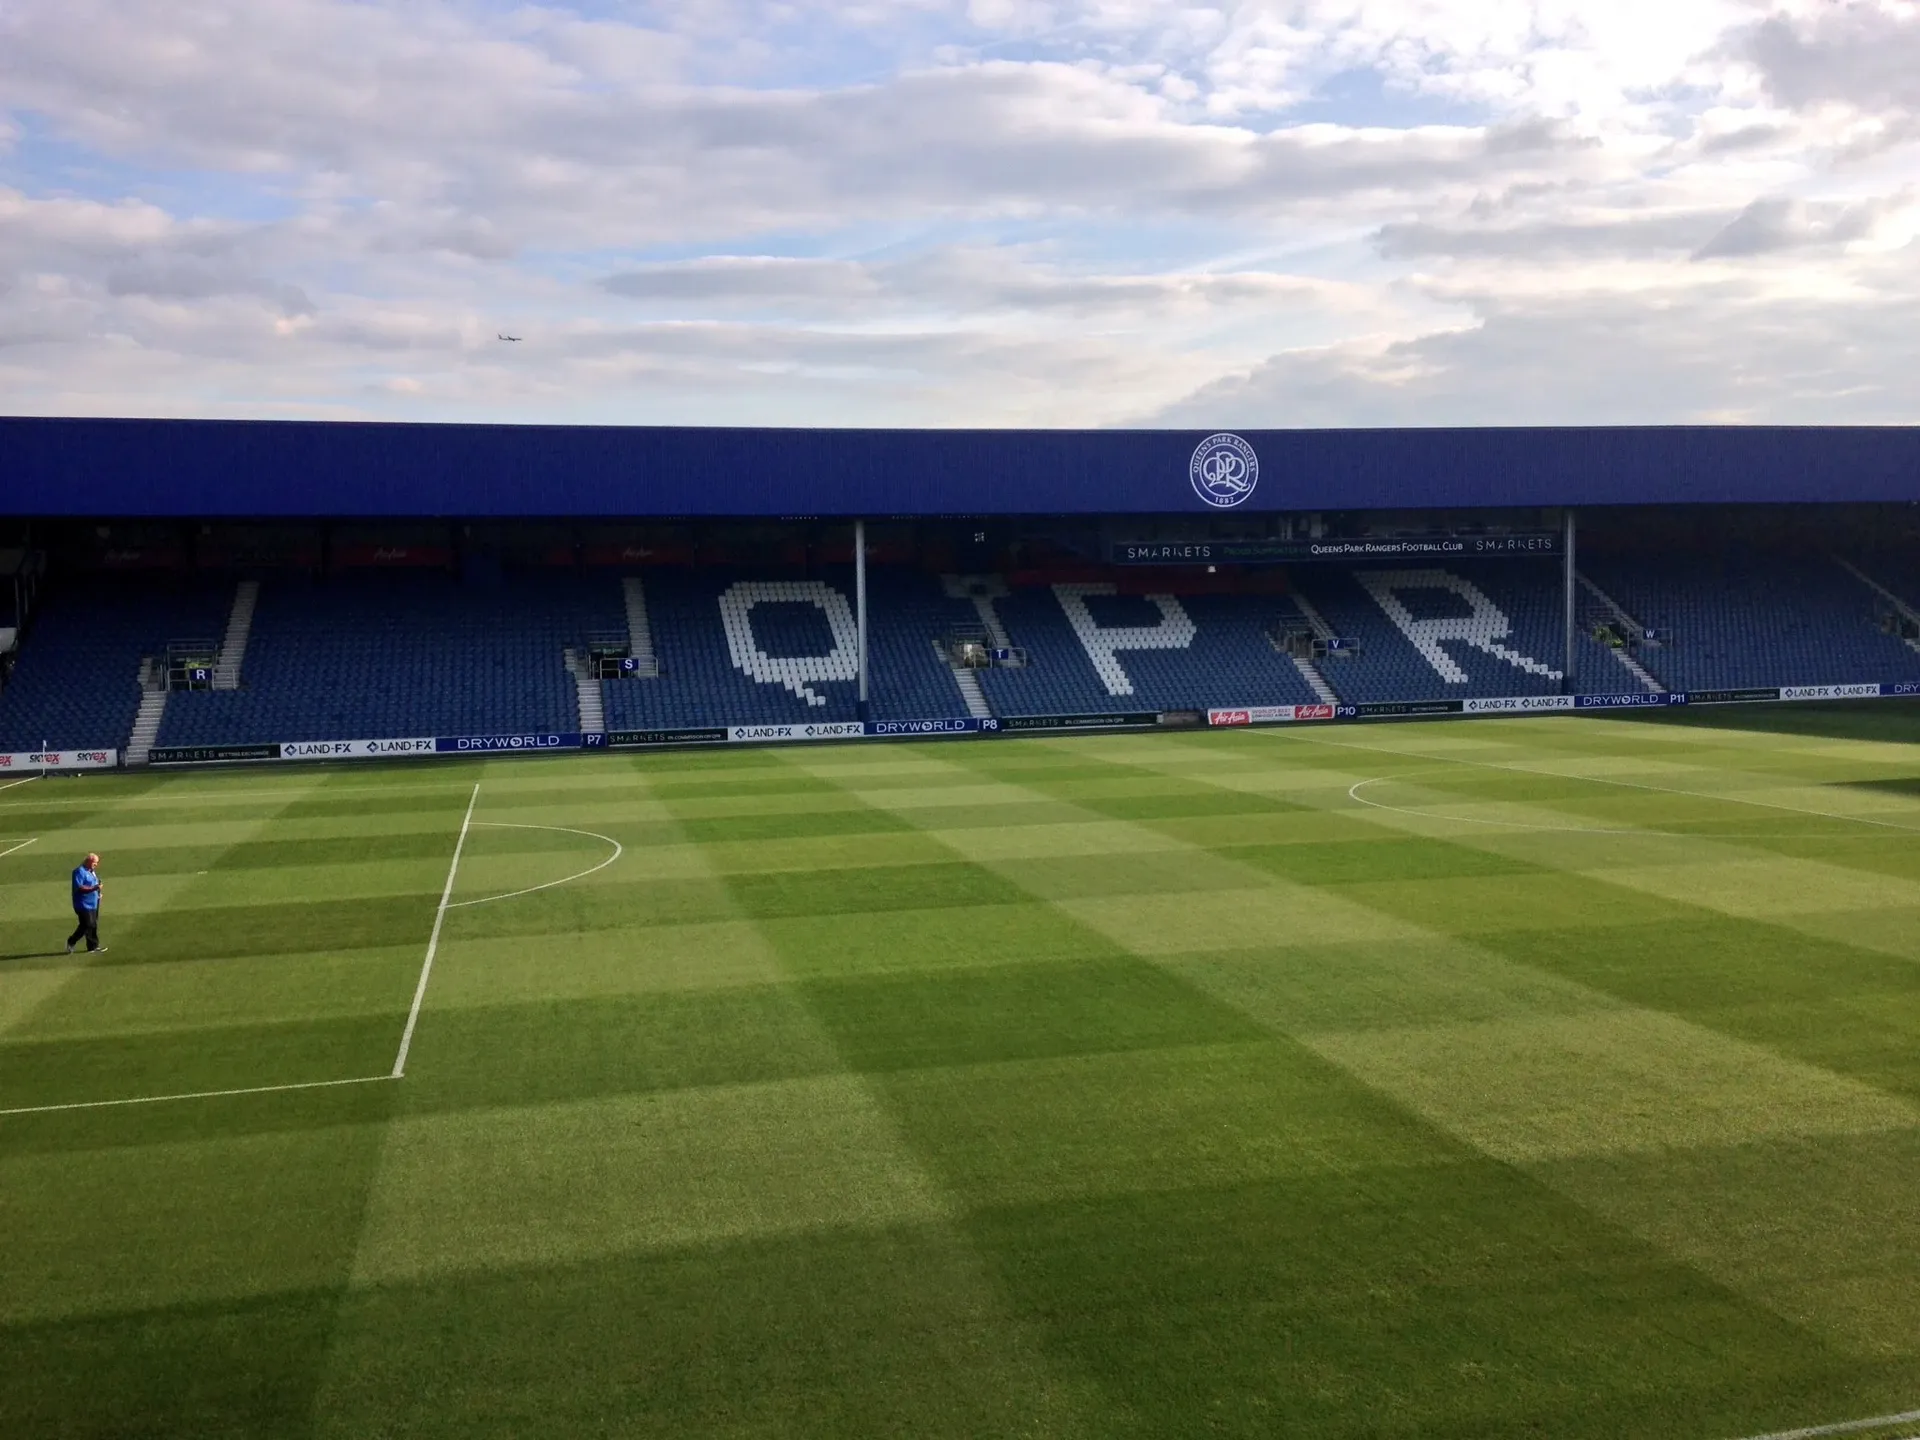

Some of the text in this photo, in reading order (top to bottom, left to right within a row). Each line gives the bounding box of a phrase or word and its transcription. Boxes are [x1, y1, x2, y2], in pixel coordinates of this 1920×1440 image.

[1193, 436, 1256, 473] QUEENS PARK RANGERS
[1215, 496, 1234, 504] 1882
[1311, 544, 1343, 554] QUEENS
[1344, 543, 1364, 552] PARK
[1365, 543, 1401, 552] RANGERS
[1402, 542, 1441, 551] FOOTBALL
[1442, 541, 1463, 550] CLUB
[1645, 630, 1655, 639] W
[1333, 640, 1339, 649] V
[996, 649, 1003, 659] T
[625, 659, 633, 669] S
[196, 669, 205, 680] R
[1794, 688, 1829, 697] LAND-FX
[1842, 685, 1877, 695] LAND-FX
[1531, 698, 1569, 707] LAND-FX
[1583, 694, 1659, 706] DRYWORLD
[1670, 693, 1685, 703] P11
[1478, 699, 1517, 709] LAND-FX
[1337, 706, 1356, 716] P10
[816, 724, 860, 735] LAND-FX
[876, 720, 965, 733] DRYWORLD
[983, 719, 998, 730] P8
[747, 727, 792, 738] LAND-FX
[457, 735, 560, 749] DRYWORLD
[587, 734, 602, 745] P7
[298, 743, 351, 755] LAND-FX
[380, 740, 432, 751] LAND-FX
